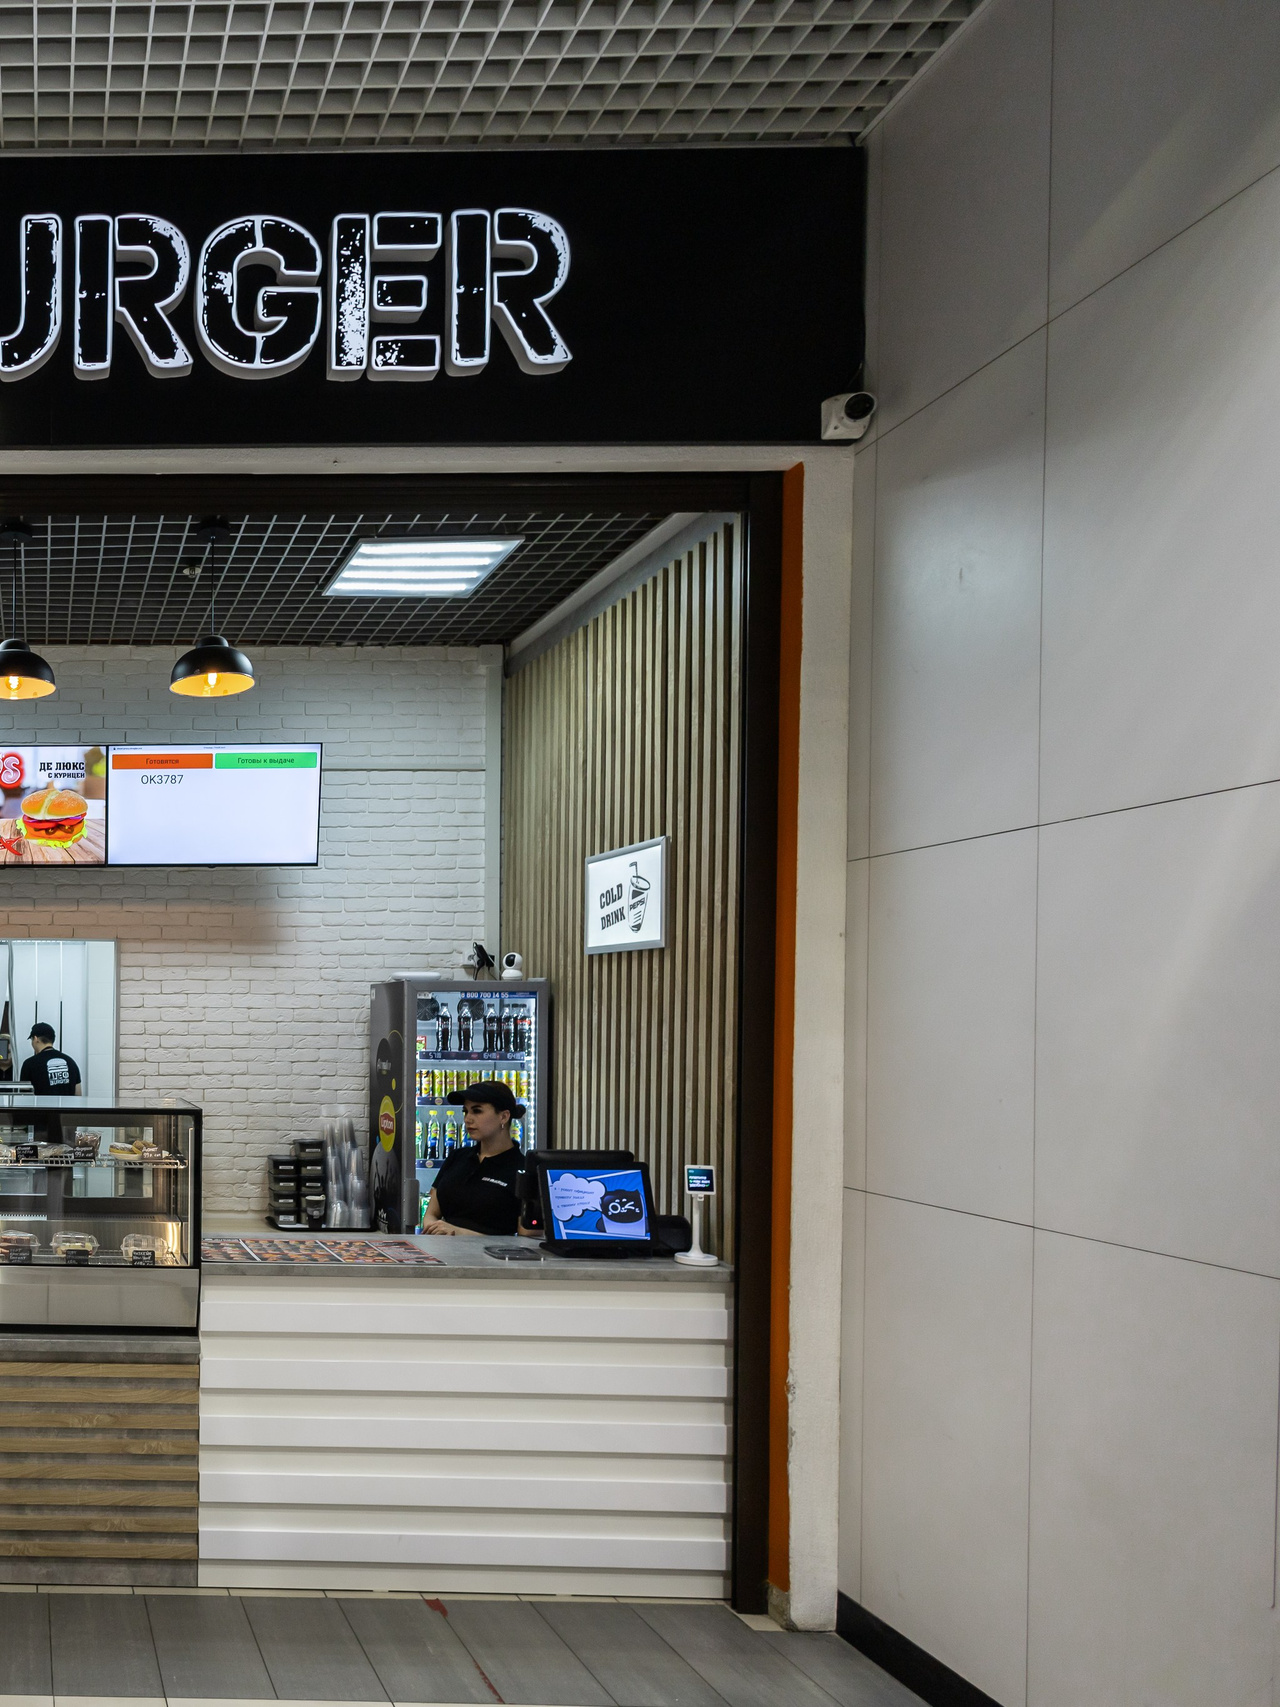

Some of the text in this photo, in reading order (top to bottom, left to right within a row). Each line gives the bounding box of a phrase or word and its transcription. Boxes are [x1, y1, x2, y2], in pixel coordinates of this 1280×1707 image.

[39, 761, 86, 772] ДЕ ЛЮКС
[237, 757, 262, 765] Готовы
[269, 758, 295, 766] выдаче
[599, 883, 623, 909] COLD
[601, 906, 626, 930] DRINK
[380, 1117, 394, 1130] Lipton
